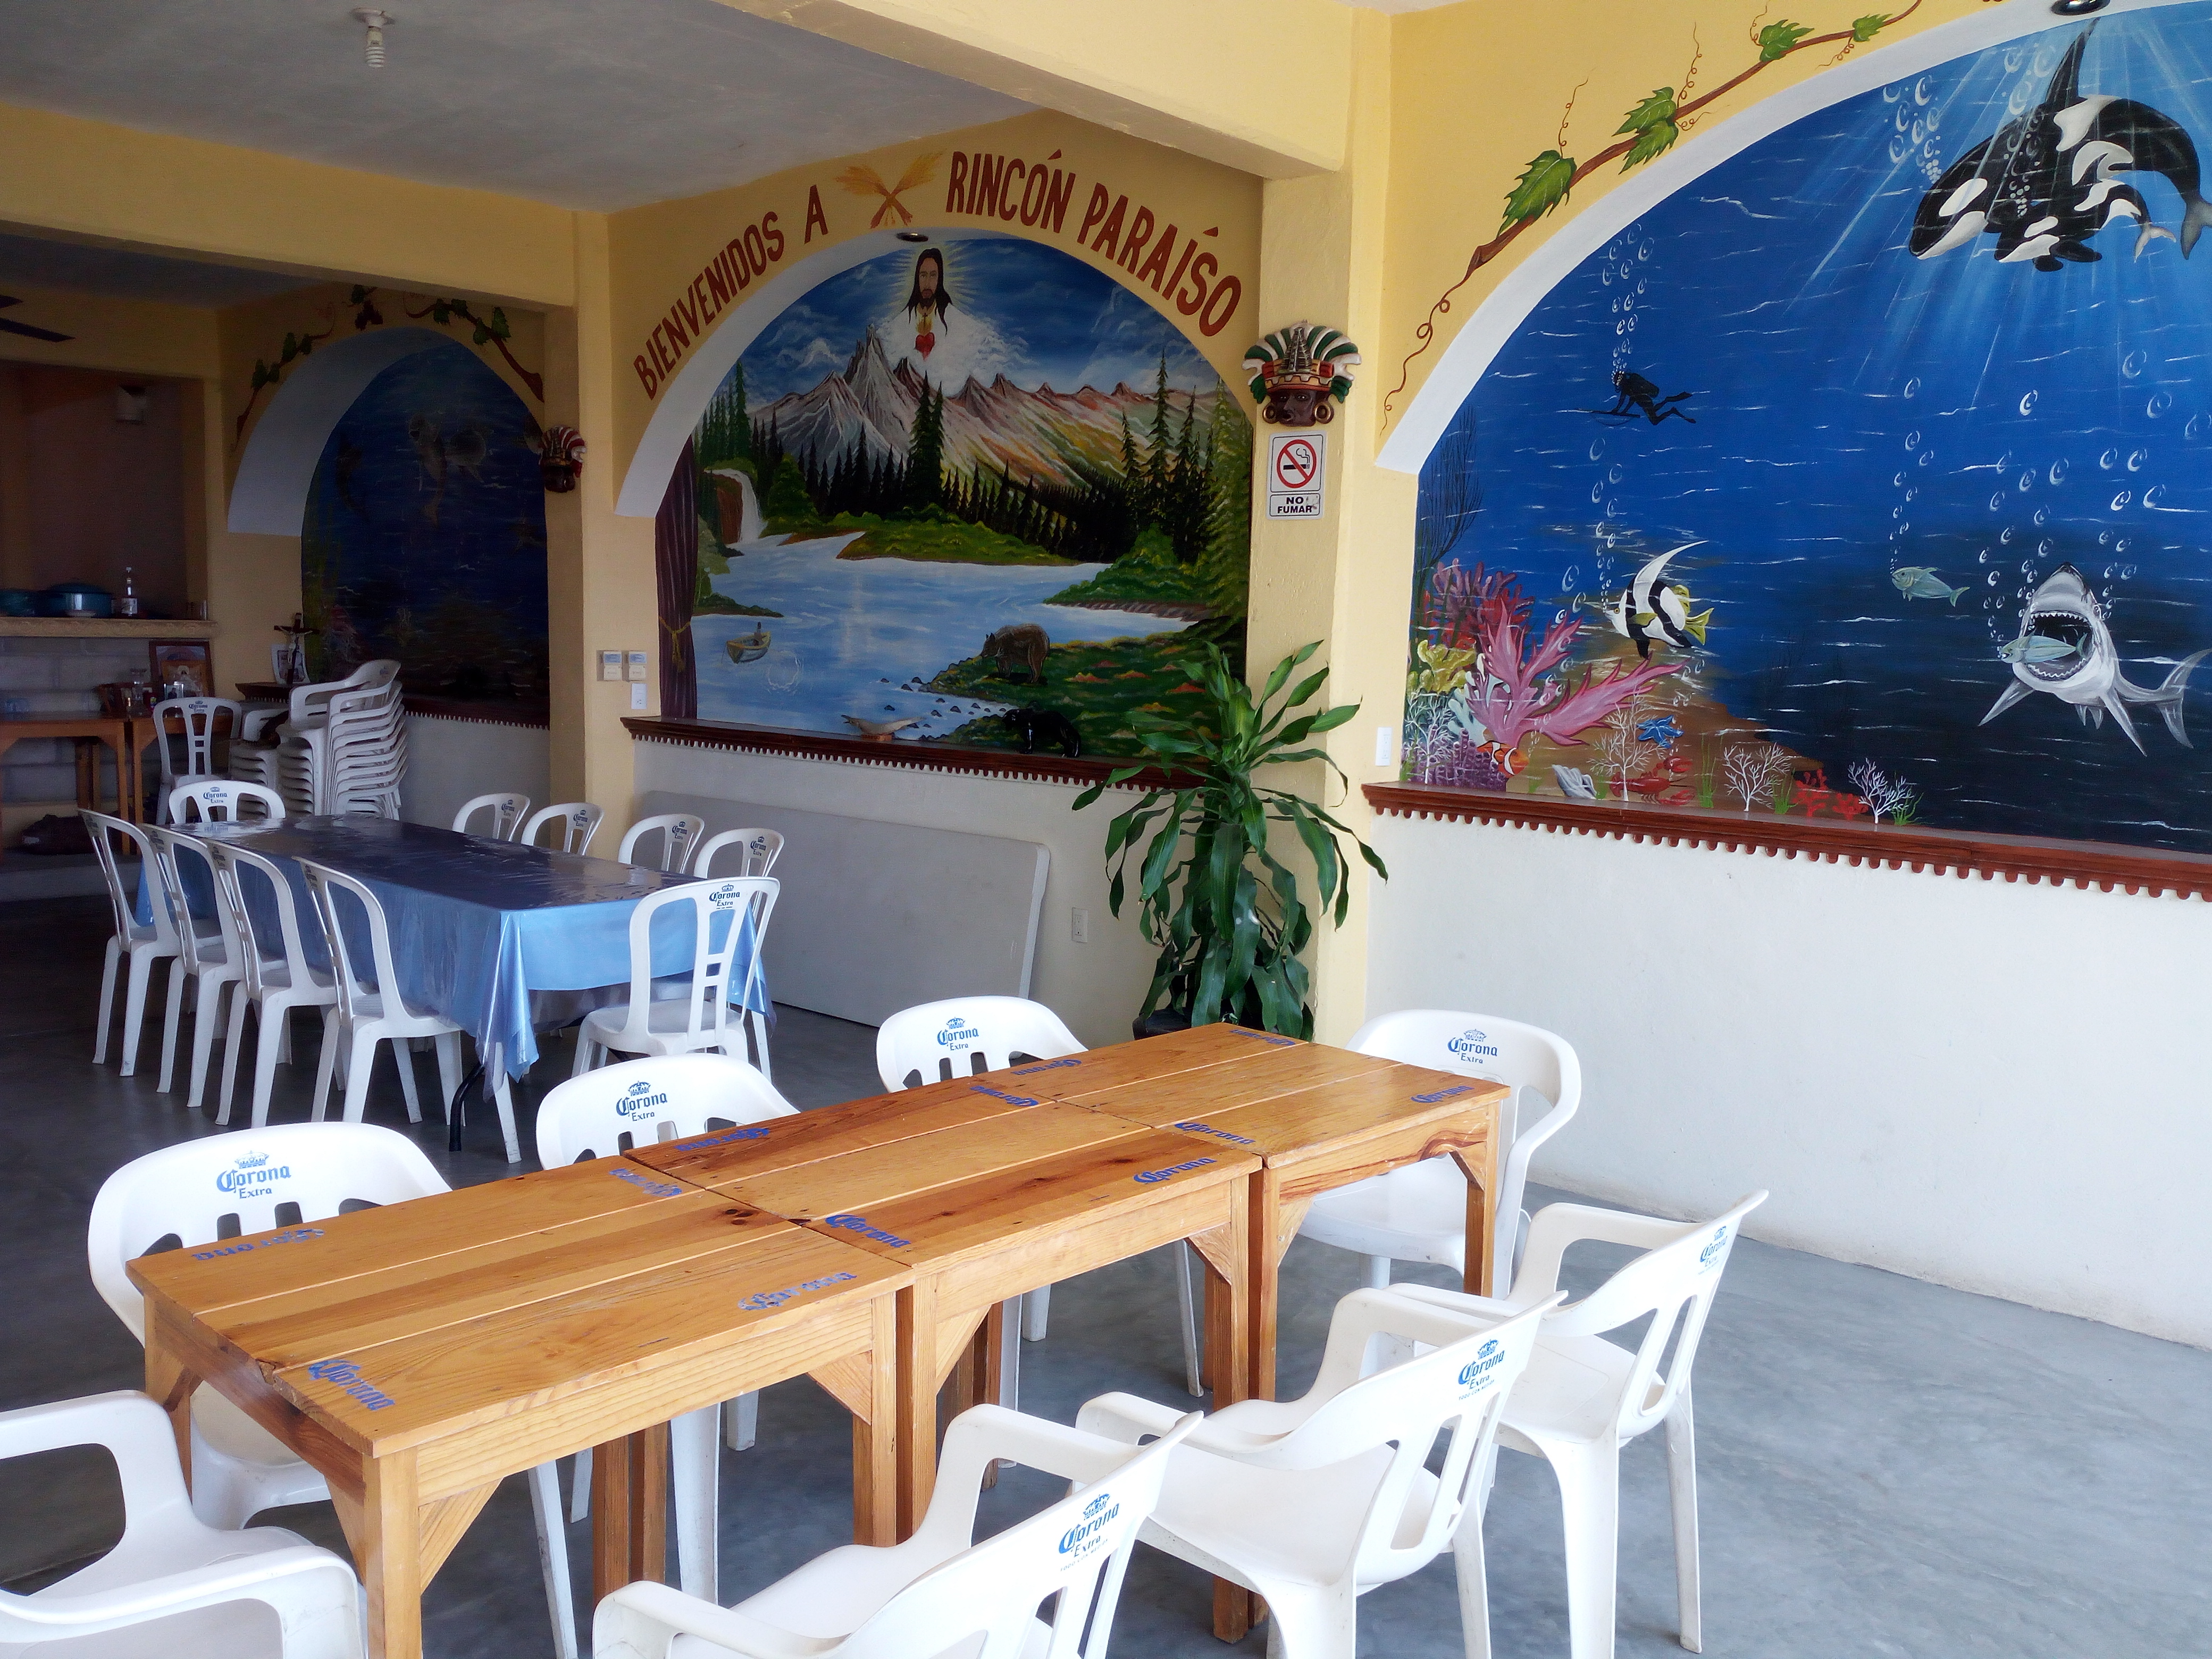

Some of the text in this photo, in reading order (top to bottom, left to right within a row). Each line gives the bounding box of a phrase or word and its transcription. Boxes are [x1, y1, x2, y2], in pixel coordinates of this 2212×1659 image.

[633, 149, 1243, 400] BIENVENIDOS A RINCÓN PARAÍSO
[709, 891, 740, 902] Corona
[937, 1027, 979, 1046] Corona
[1447, 1037, 1498, 1057] Corona
[1461, 1053, 1484, 1063] Extra
[616, 1093, 668, 1117] Corona
[1411, 1085, 1475, 1103] Corona
[632, 1111, 655, 1121] Extra
[1174, 1122, 1255, 1144] Corona
[216, 1166, 291, 1193] Corona
[1133, 1157, 1217, 1184] Corona
[239, 1188, 272, 1199] Extra
[825, 1214, 911, 1248] Corona
[738, 1272, 858, 1311] Corona
[1458, 1350, 1505, 1385] Corona
[308, 1359, 396, 1411] Corona
[1469, 1375, 1489, 1389] Extra
[1059, 1503, 1120, 1554] Corona
[1074, 1536, 1101, 1557] Extra
